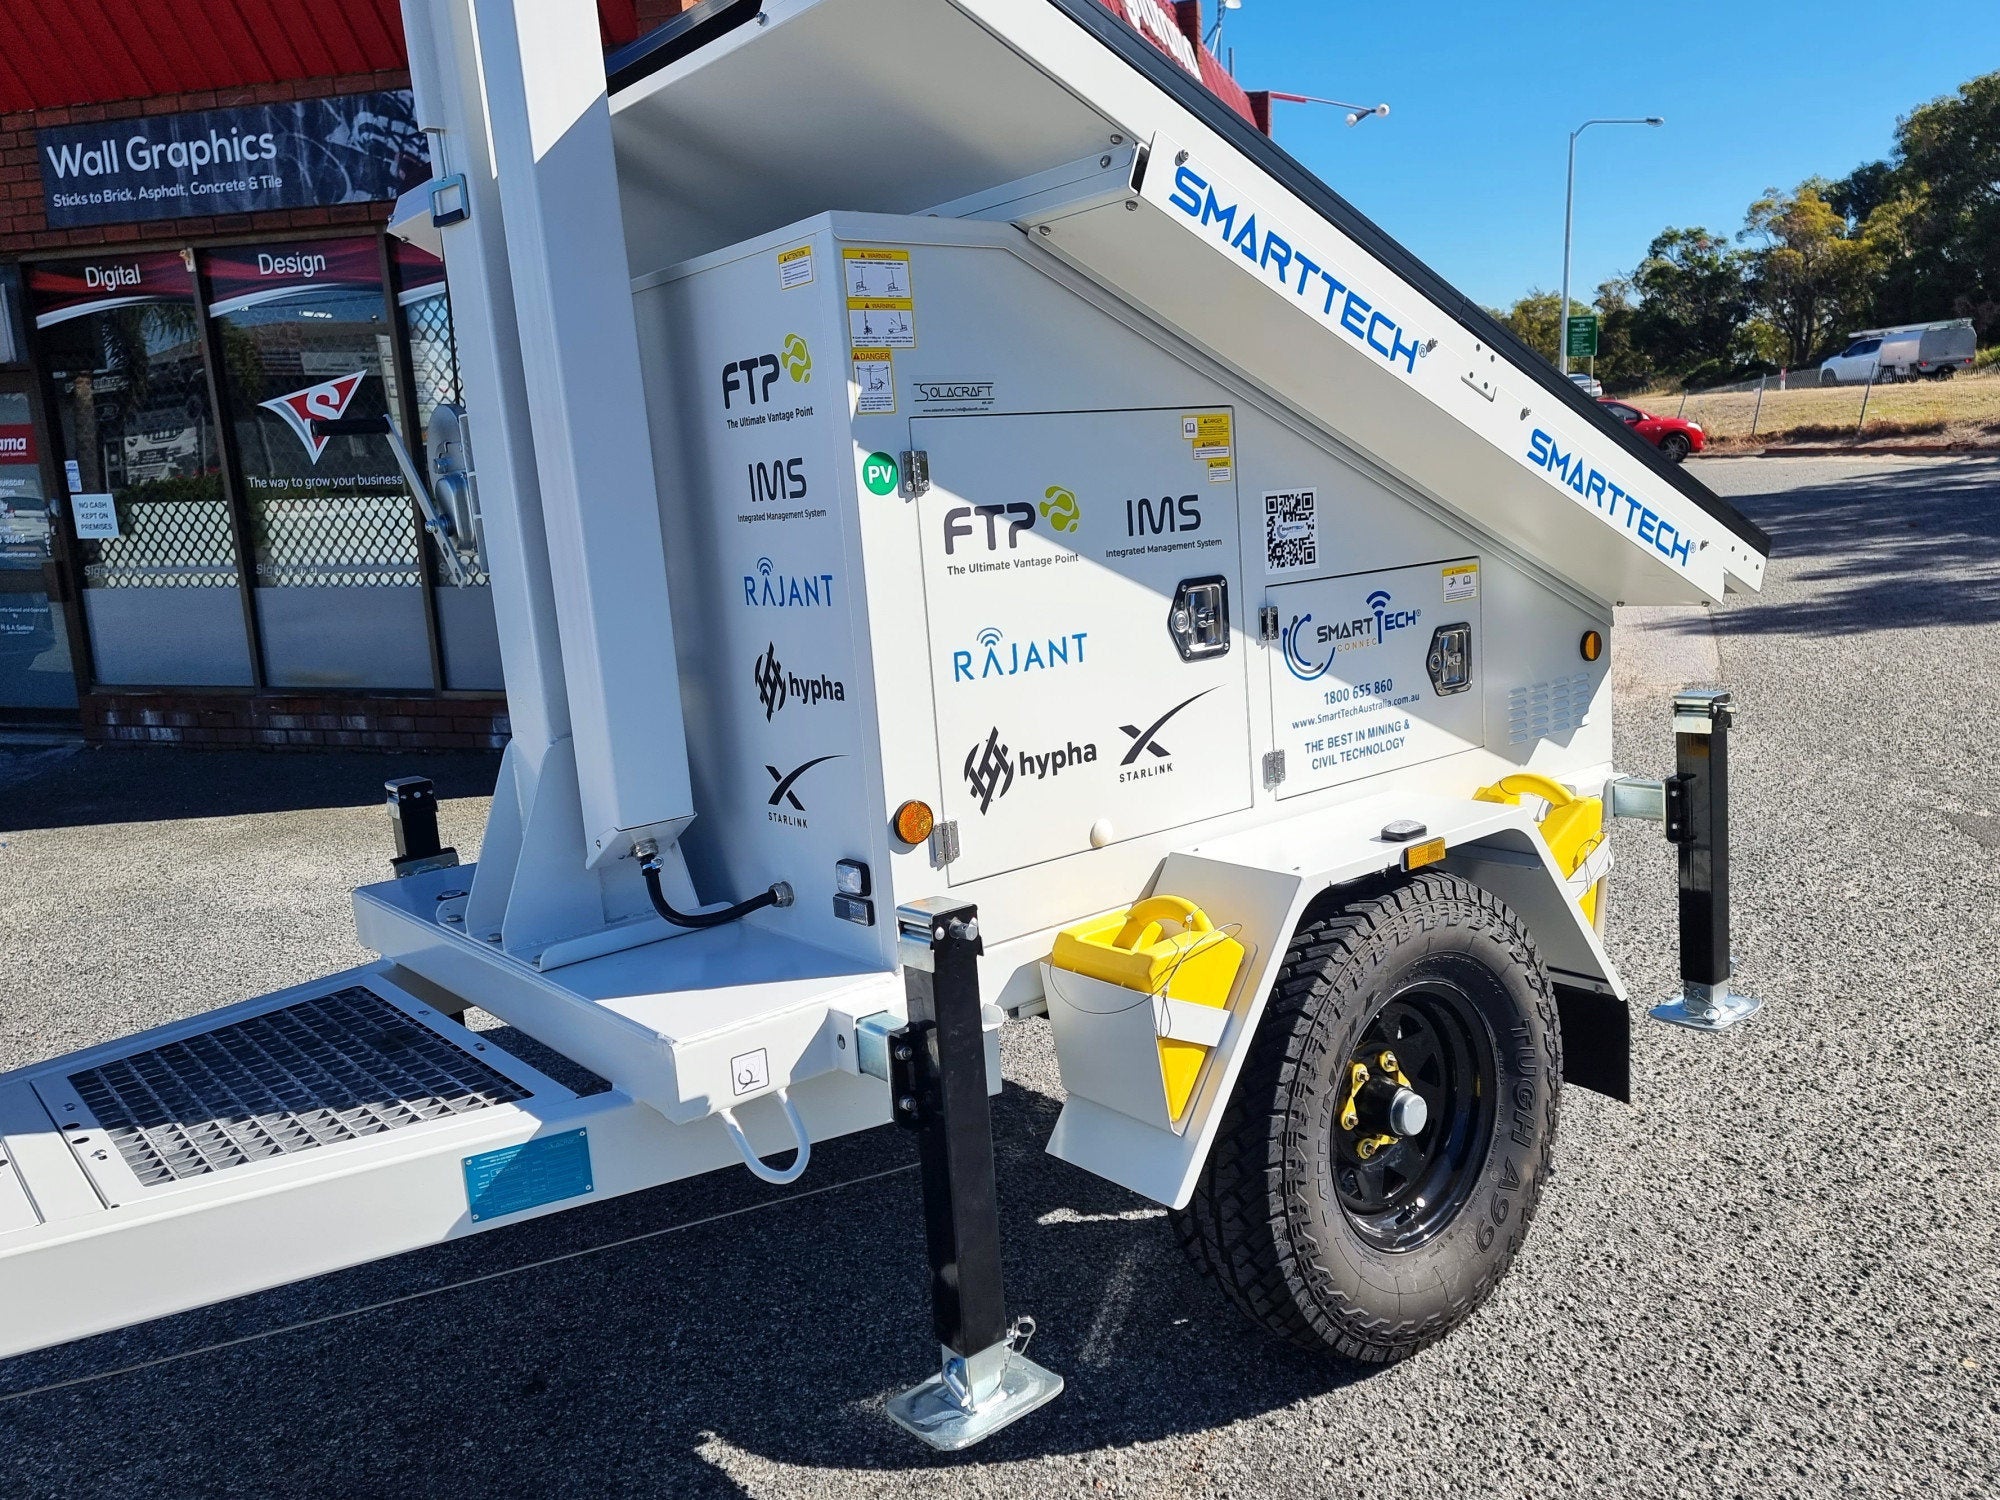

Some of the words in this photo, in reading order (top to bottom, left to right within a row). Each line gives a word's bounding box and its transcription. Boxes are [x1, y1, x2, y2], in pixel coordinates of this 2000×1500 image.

[46, 139, 120, 178] Wall
[125, 127, 278, 175] Graphics
[53, 193, 88, 207] Sticks
[89, 193, 102, 204] to
[104, 187, 136, 203] Brick,
[138, 183, 189, 201] Asphalt,
[190, 179, 246, 196] Concrete
[248, 177, 259, 190] &
[259, 175, 283, 188] Tile
[85, 264, 141, 291] Digital
[258, 251, 326, 281] Design
[860, 352, 890, 360] DANGER
[722, 353, 781, 410] FTP
[920, 383, 993, 401] SOLACRAFT
[726, 419, 739, 430] The
[739, 414, 766, 428] Ultimate
[767, 410, 794, 425] Vantage
[794, 406, 814, 418] Point
[247, 476, 268, 488] The
[268, 479, 289, 491] way
[291, 477, 303, 487] to
[304, 478, 330, 490] grow
[332, 476, 355, 489] your
[358, 474, 403, 486] business
[748, 457, 807, 502] IMS
[868, 465, 893, 484] PV
[737, 512, 766, 523] Integrated
[766, 511, 804, 522] Management
[804, 508, 827, 519] System
[943, 502, 1036, 555] FTP
[1126, 494, 1202, 537] IMS
[947, 565, 965, 576] The
[968, 560, 1010, 573] Ultimate
[1013, 555, 1052, 569] Vantage
[1055, 552, 1079, 563] Point
[1105, 546, 1145, 558] Integrated
[1147, 541, 1196, 555] Management
[1198, 538, 1222, 550] System
[743, 574, 833, 607] RAJANT
[953, 632, 1087, 682] RAJANT
[788, 671, 845, 706] hypha
[1324, 688, 1349, 705] 1800
[1353, 683, 1371, 699] 655
[1374, 678, 1393, 694] 860
[1292, 693, 1420, 729] www.SmartTechAustralia.com.au
[1305, 739, 1324, 754] THE
[1327, 732, 1353, 749] BEST
[1355, 729, 1365, 742] IN
[1367, 721, 1401, 738] MINING
[1403, 719, 1410, 729] &
[1019, 741, 1097, 780] hypha
[1312, 754, 1337, 770] CIVIL
[1340, 737, 1405, 762] TECHNOLOGY
[1119, 762, 1174, 783] STARLINK
[768, 812, 808, 829] STARLINK
[1510, 1018, 1537, 1149] TUGH
[1476, 1156, 1520, 1253] A99
